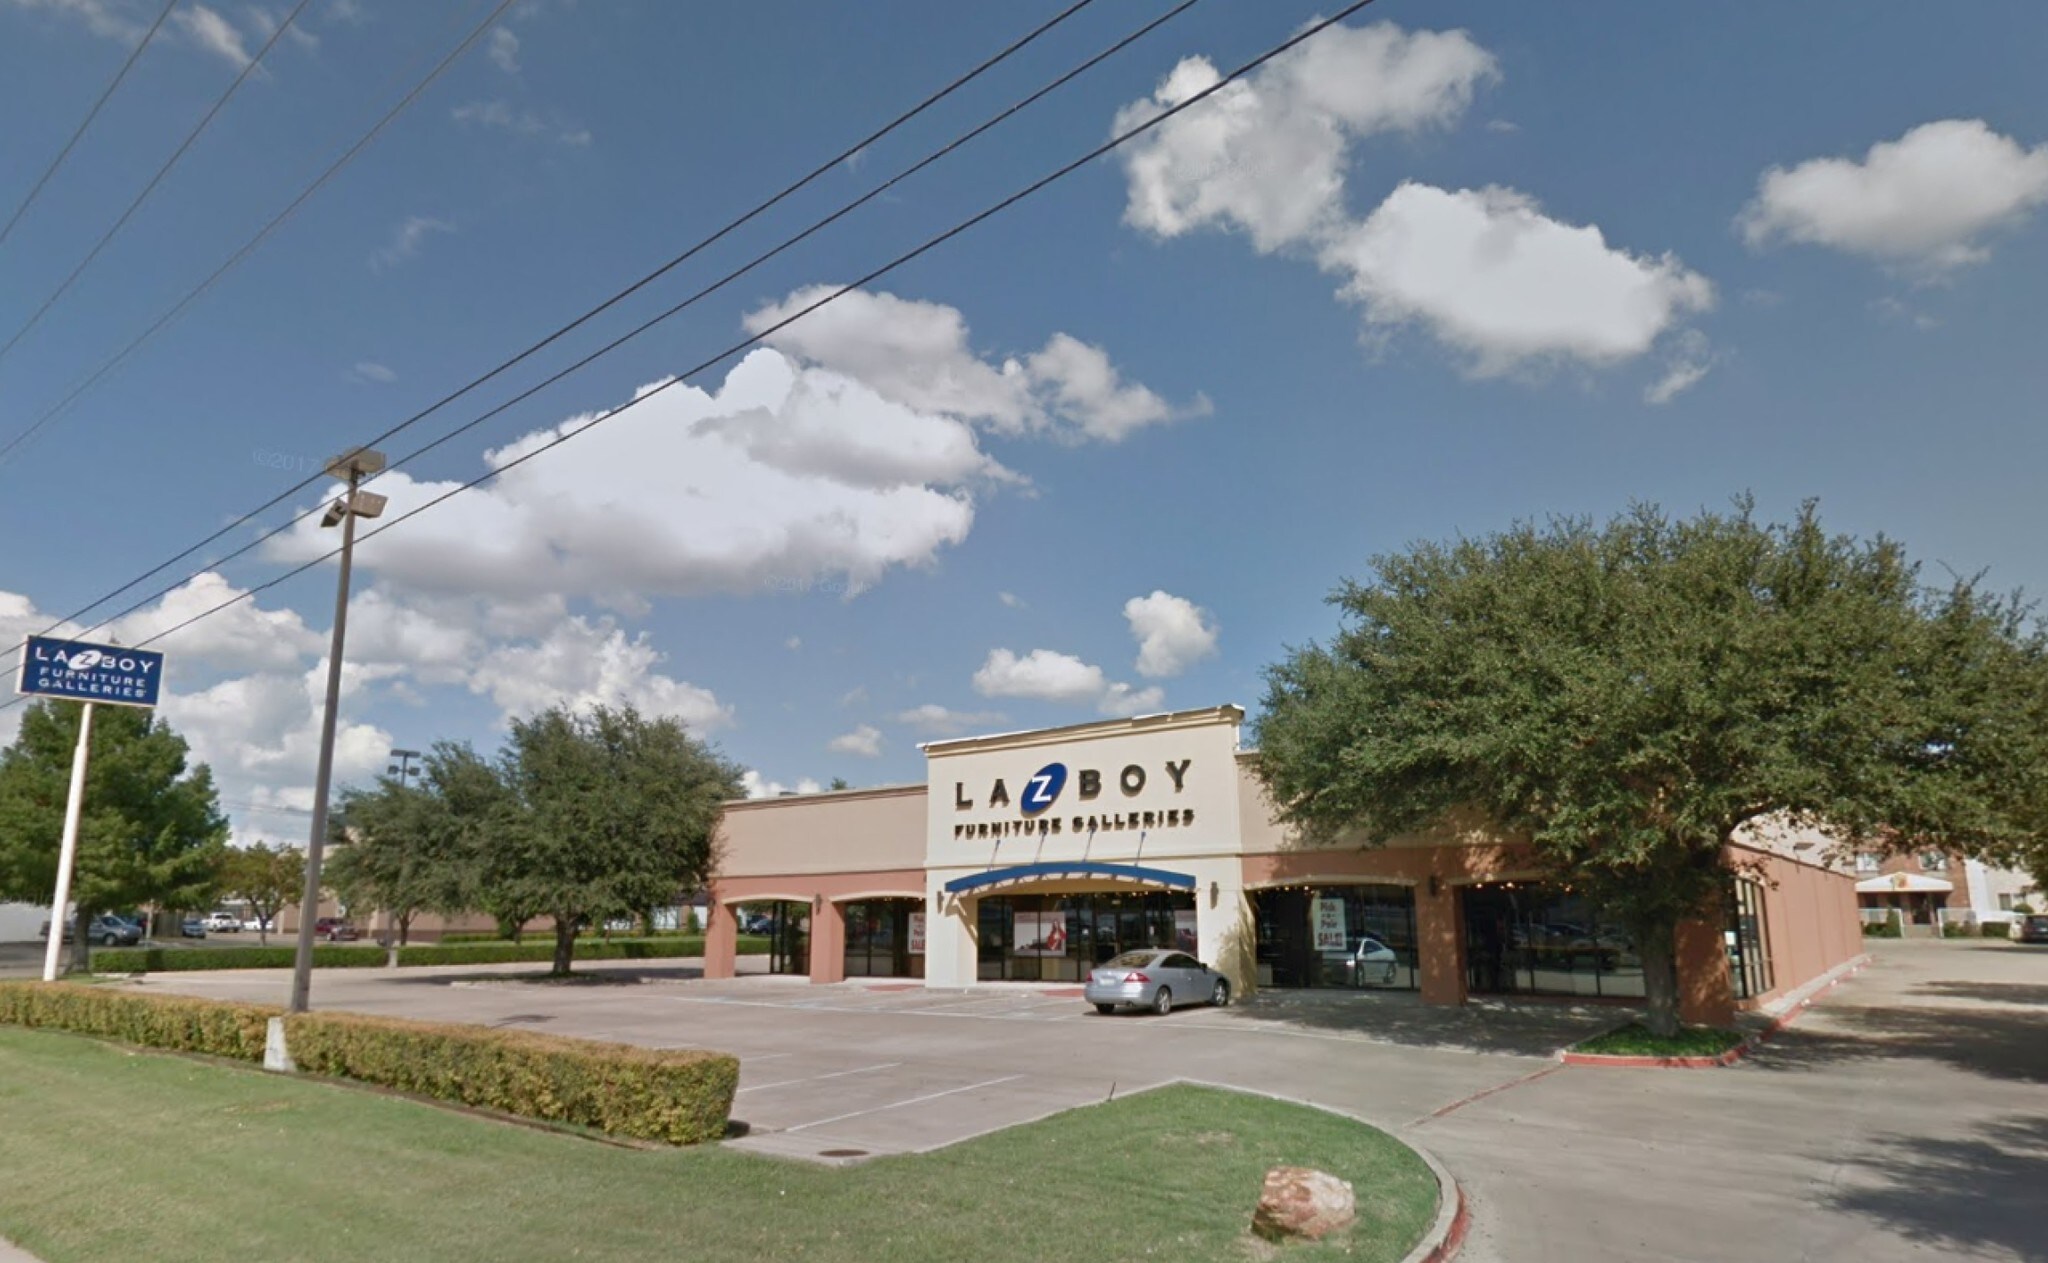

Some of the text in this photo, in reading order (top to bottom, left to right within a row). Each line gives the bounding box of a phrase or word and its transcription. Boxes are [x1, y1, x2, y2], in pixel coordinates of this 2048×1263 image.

[38, 678, 146, 698] GALLERIES
[39, 667, 146, 688] FURNITURE
[954, 808, 1195, 840] FURNITURE GALLERIES
